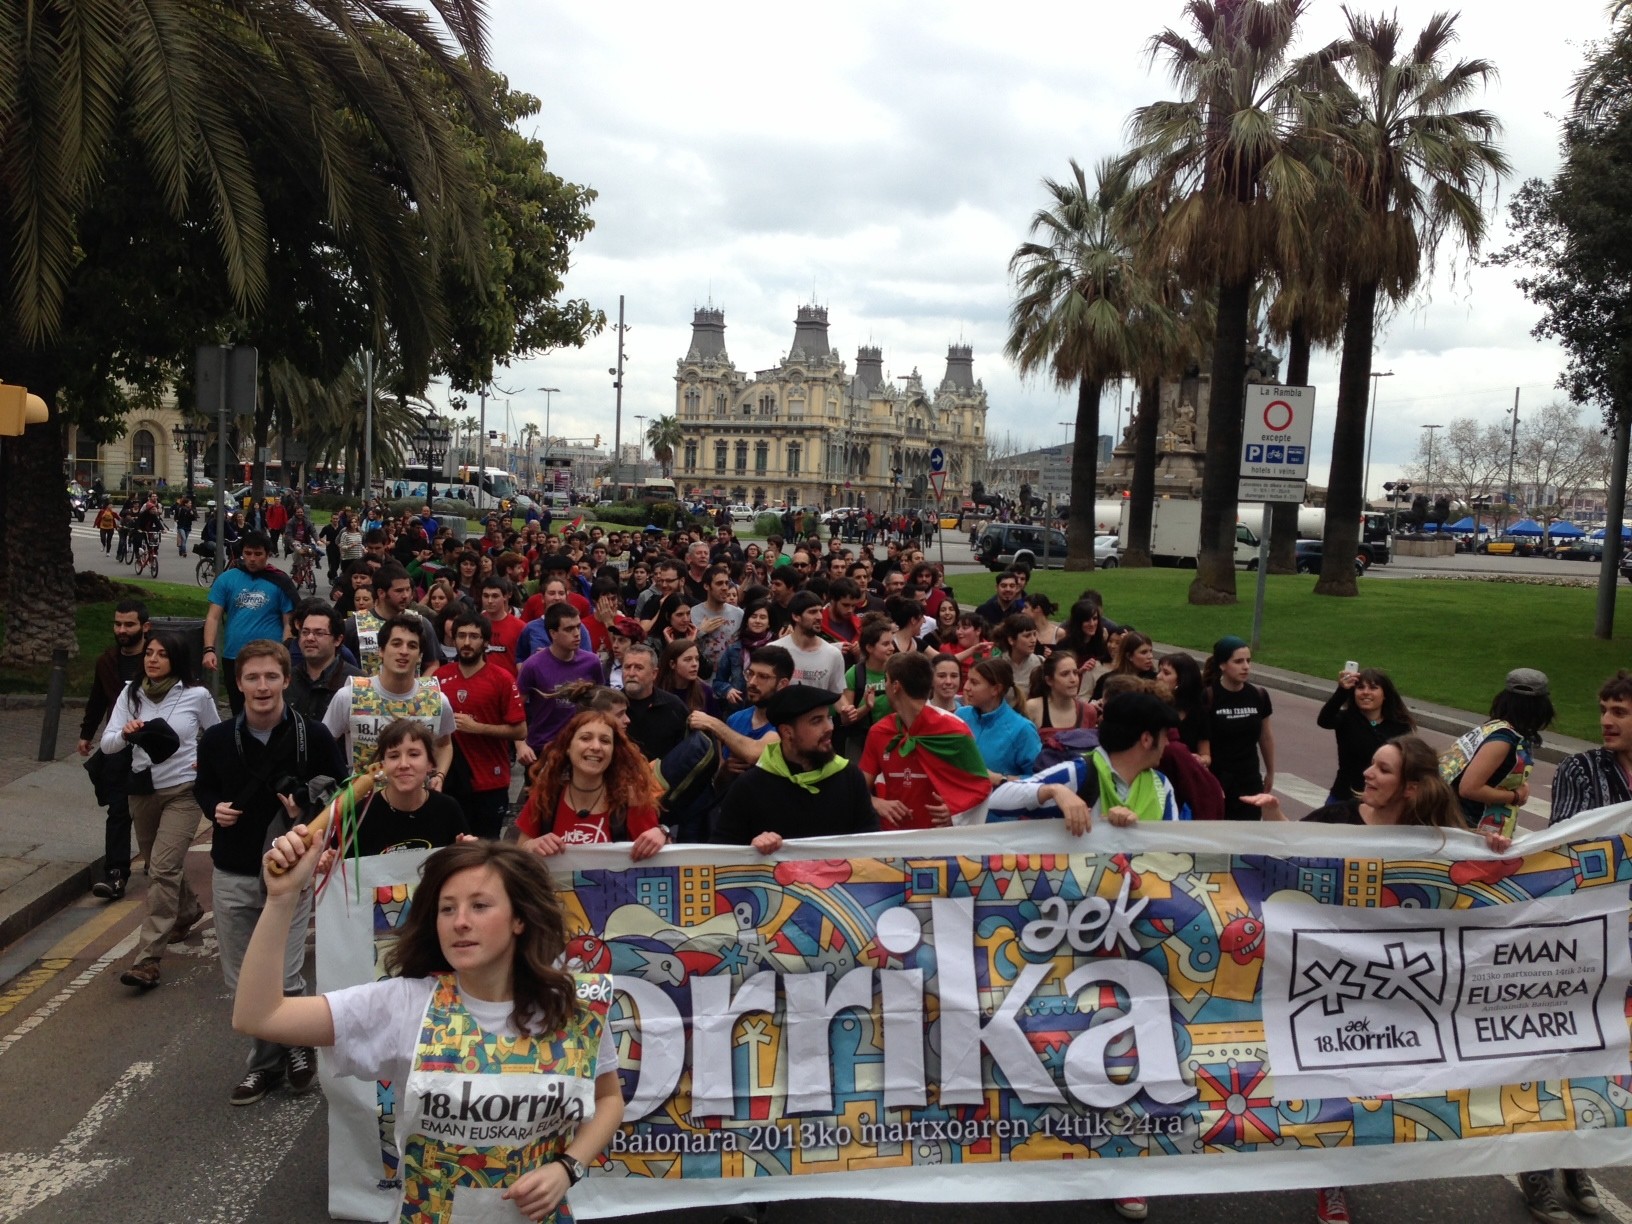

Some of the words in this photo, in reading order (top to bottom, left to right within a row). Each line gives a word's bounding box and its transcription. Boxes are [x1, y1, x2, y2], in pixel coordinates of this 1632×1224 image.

[1260, 387, 1270, 396] La
[1273, 388, 1302, 397] Rambla
[1261, 434, 1292, 443] excepte
[1248, 446, 1261, 461] P
[1251, 466, 1271, 475] hotels
[297, 722, 305, 752] OLYMPUS
[1021, 871, 1149, 953] aek
[1493, 938, 1577, 966] EMAN
[1471, 972, 1501, 982] 2013ko
[1503, 969, 1553, 979] martxoaren
[1576, 965, 1597, 974] 24ra
[576, 979, 611, 1003] aek
[1467, 978, 1588, 1005] EUSKARA
[605, 895, 1198, 1122] orrika
[1344, 1016, 1371, 1032] aek
[1475, 1010, 1577, 1043] ELKARRI
[1313, 1024, 1422, 1053] 18.korrika
[418, 1080, 584, 1123] 18.korrika
[420, 1118, 466, 1139] EMAN
[469, 1124, 534, 1141] EUSKARA
[611, 1128, 738, 1154] Baionara
[749, 1121, 851, 1151] 2013ko
[861, 1114, 1031, 1145] martxoaren
[1041, 1113, 1112, 1138] 14tik
[1119, 1112, 1184, 1136] 24ra
